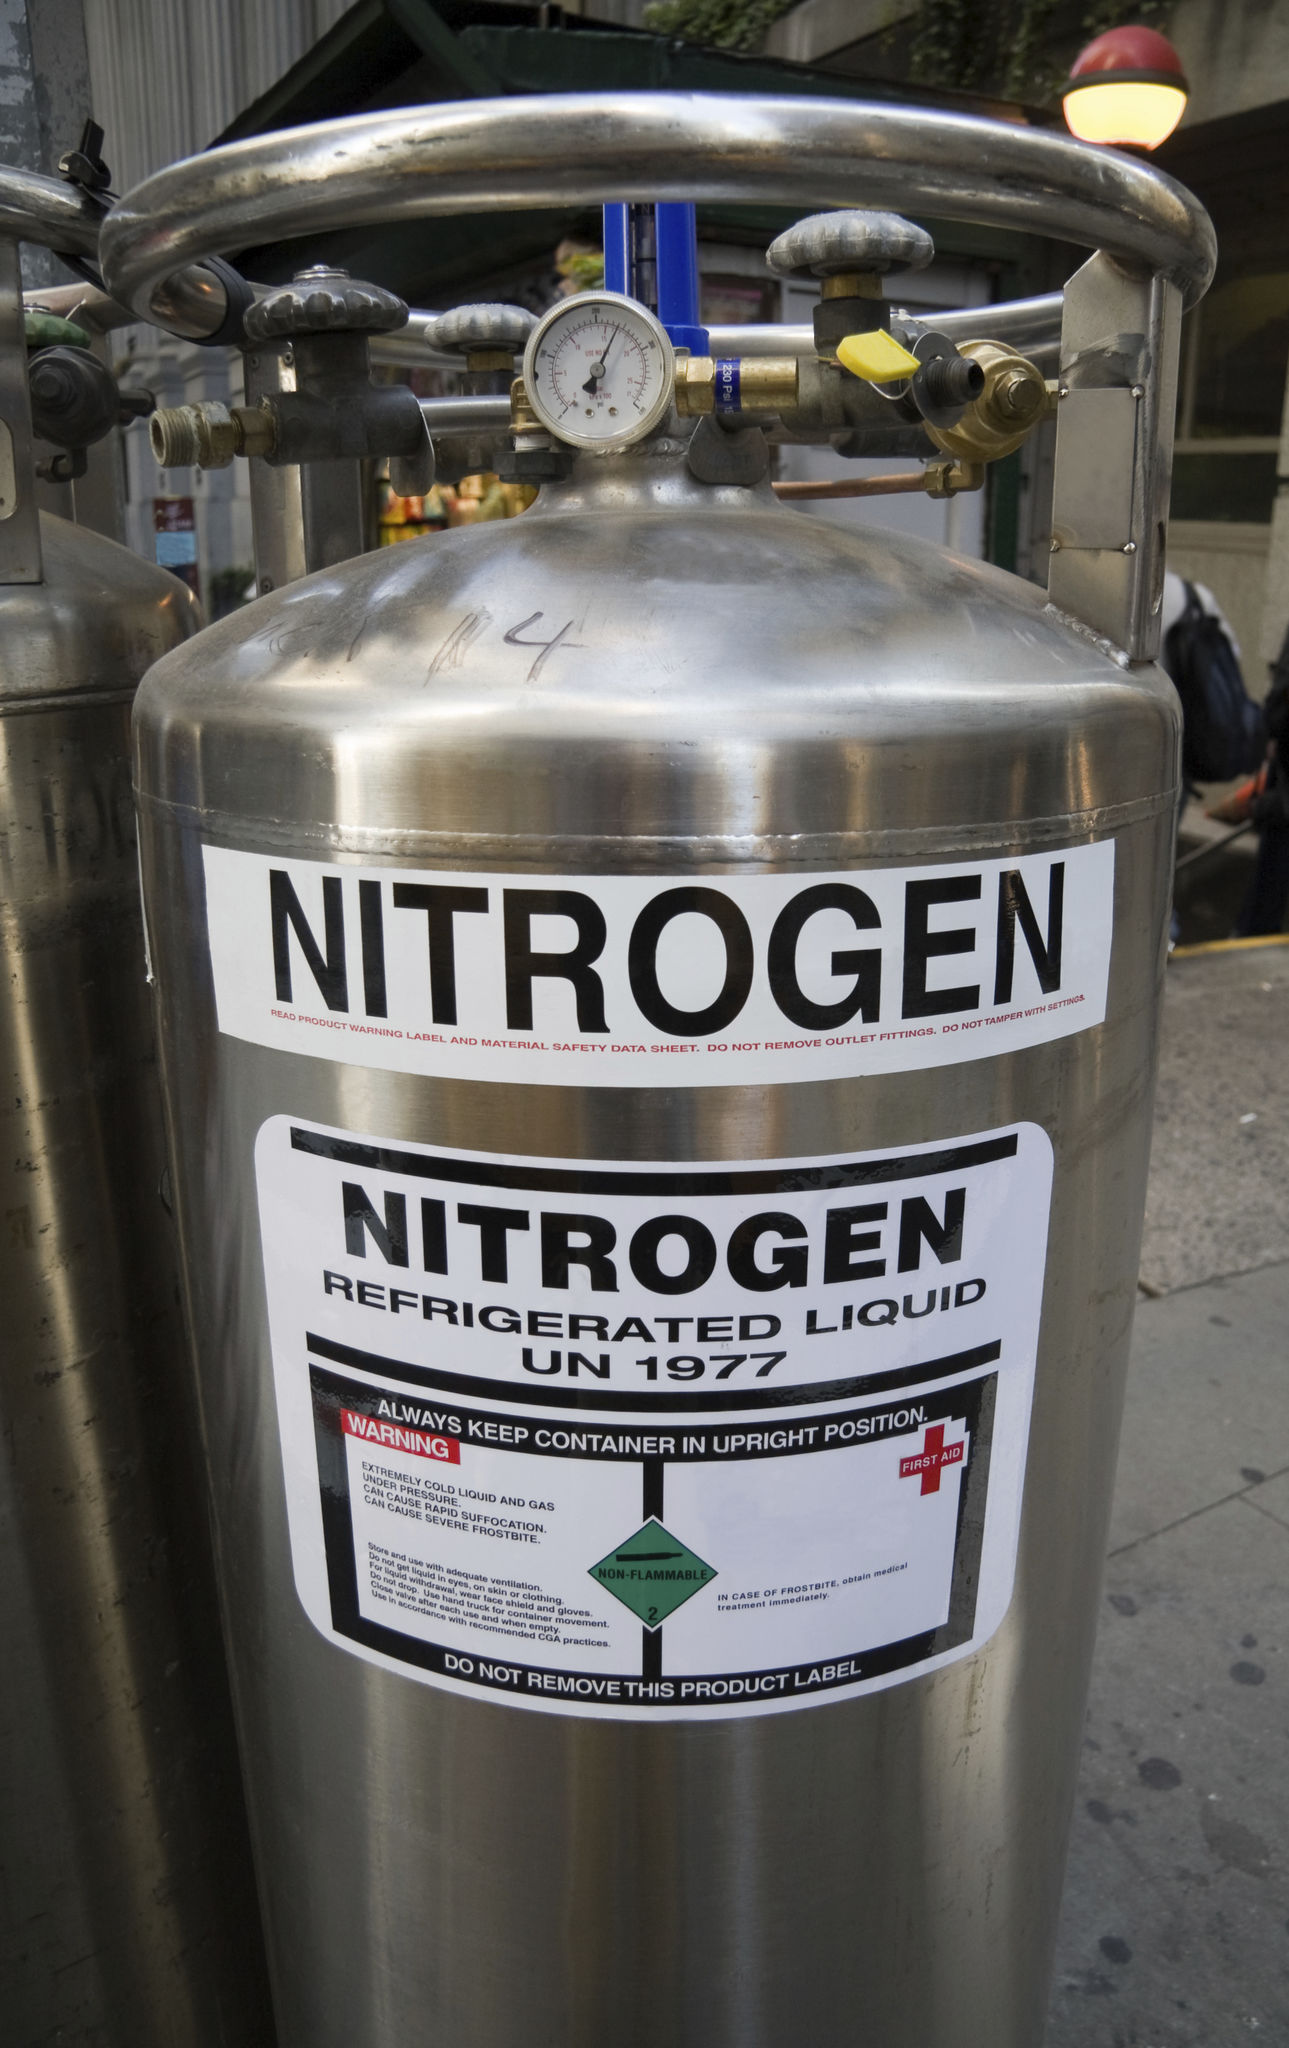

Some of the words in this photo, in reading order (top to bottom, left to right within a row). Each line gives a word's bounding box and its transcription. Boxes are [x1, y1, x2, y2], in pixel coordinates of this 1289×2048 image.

[722, 365, 732, 383] 230
[269, 861, 1065, 1037] NITROGEN
[271, 1009, 296, 1021] READ
[298, 1015, 347, 1030] PRODUCT
[350, 1024, 402, 1038] WARNING
[406, 1032, 447, 1043] LABEL
[450, 1037, 478, 1046] AND
[481, 1039, 549, 1050] MATERIAL
[552, 1043, 608, 1052] SAFETY
[611, 1044, 647, 1053] DATA
[650, 1044, 700, 1053] SHEET.
[707, 1043, 728, 1052] DO
[732, 1042, 761, 1052] NOT
[764, 1039, 822, 1050] REMOVE
[825, 1034, 876, 1046] OUTLET
[880, 1027, 937, 1041] FITTINGS.
[942, 1024, 959, 1033] DO
[961, 1020, 983, 1031] NOT
[984, 1011, 1023, 1026] TAMPER
[1024, 1005, 1046, 1017] WITH
[341, 1181, 966, 1295] NITROGEN
[323, 1270, 782, 1343] REFRIGERATED
[805, 1278, 986, 1336] LIQUID
[522, 1348, 610, 1379] UN
[636, 1351, 787, 1381] 1977
[348, 1413, 449, 1459] WARNING
[378, 1399, 462, 1434] ALWAYS
[468, 1419, 528, 1443] KEEP
[534, 1429, 675, 1454] CONTAINER
[682, 1436, 706, 1453] IN
[713, 1427, 819, 1453] UPRIGHT
[824, 1405, 928, 1442] POSITION.
[902, 1454, 938, 1472] FIRST
[941, 1448, 960, 1462] AID
[362, 1461, 421, 1486] EXTREMELY
[425, 1480, 455, 1495] COLD
[458, 1488, 496, 1503] LIQUID
[500, 1496, 525, 1507] AND
[529, 1500, 555, 1512] GAS
[363, 1473, 397, 1491] UNDER
[400, 1485, 462, 1507] PRESSURE.
[364, 1484, 385, 1498] CAN
[386, 1492, 422, 1508] CAUSE
[425, 1503, 458, 1518] RAPID
[461, 1511, 547, 1534] SUFFOCATION.
[364, 1495, 385, 1508] CAN
[388, 1503, 422, 1520] CAUSE
[425, 1514, 469, 1531] SEVERE
[472, 1525, 541, 1544] FROSTBITE.
[368, 1542, 389, 1556] Store
[391, 1551, 406, 1561] and
[408, 1557, 424, 1567] use
[426, 1561, 444, 1572] with
[446, 1568, 488, 1583] adequate
[490, 1578, 543, 1592] ventilation.
[369, 1551, 380, 1562] Do
[381, 1558, 395, 1567] not
[397, 1563, 410, 1572] get
[412, 1566, 435, 1580] liquid
[438, 1573, 446, 1582] in
[488, 1586, 507, 1596] skin
[522, 1593, 564, 1606] clothing.
[369, 1561, 383, 1571] For
[385, 1566, 407, 1580] liquid
[459, 1591, 481, 1600] wear
[483, 1595, 503, 1605] face
[506, 1599, 534, 1610] shield
[537, 1605, 555, 1613] and
[558, 1607, 593, 1617] gloves.
[598, 1568, 707, 1580] NON-FLAMMABLE
[732, 1591, 760, 1601] CASE
[763, 1589, 777, 1597] OF
[842, 1572, 871, 1585] obtain
[873, 1562, 908, 1578] medical
[370, 1571, 381, 1581] Do
[383, 1577, 396, 1586] not
[398, 1581, 419, 1594] drop.
[423, 1589, 440, 1599] Use
[442, 1594, 465, 1606] hand
[467, 1601, 490, 1612] truck
[492, 1606, 505, 1615] for
[507, 1610, 553, 1623] container
[555, 1617, 609, 1628] movement.
[371, 1580, 393, 1594] Close
[395, 1591, 416, 1602] valve
[418, 1598, 438, 1609] after
[440, 1604, 460, 1614] each
[462, 1610, 479, 1619] use
[482, 1614, 499, 1623] and
[502, 1618, 526, 1628] when
[529, 1623, 561, 1635] empty.
[372, 1590, 387, 1601] Use
[389, 1595, 396, 1605] in
[398, 1600, 446, 1620] accordance
[448, 1615, 467, 1626] with
[469, 1622, 536, 1640] recommended
[538, 1634, 561, 1643] CGA
[563, 1637, 611, 1647] practices.
[648, 1607, 658, 1620] 2
[718, 1601, 766, 1611] treatment
[769, 1592, 830, 1607] immediately.
[444, 1652, 475, 1675] DO
[479, 1663, 522, 1685] NOT
[527, 1673, 621, 1697] REMOVE
[624, 1681, 675, 1698] THIS
[680, 1674, 790, 1698] PRODUCT
[794, 1661, 862, 1687] LABEL
